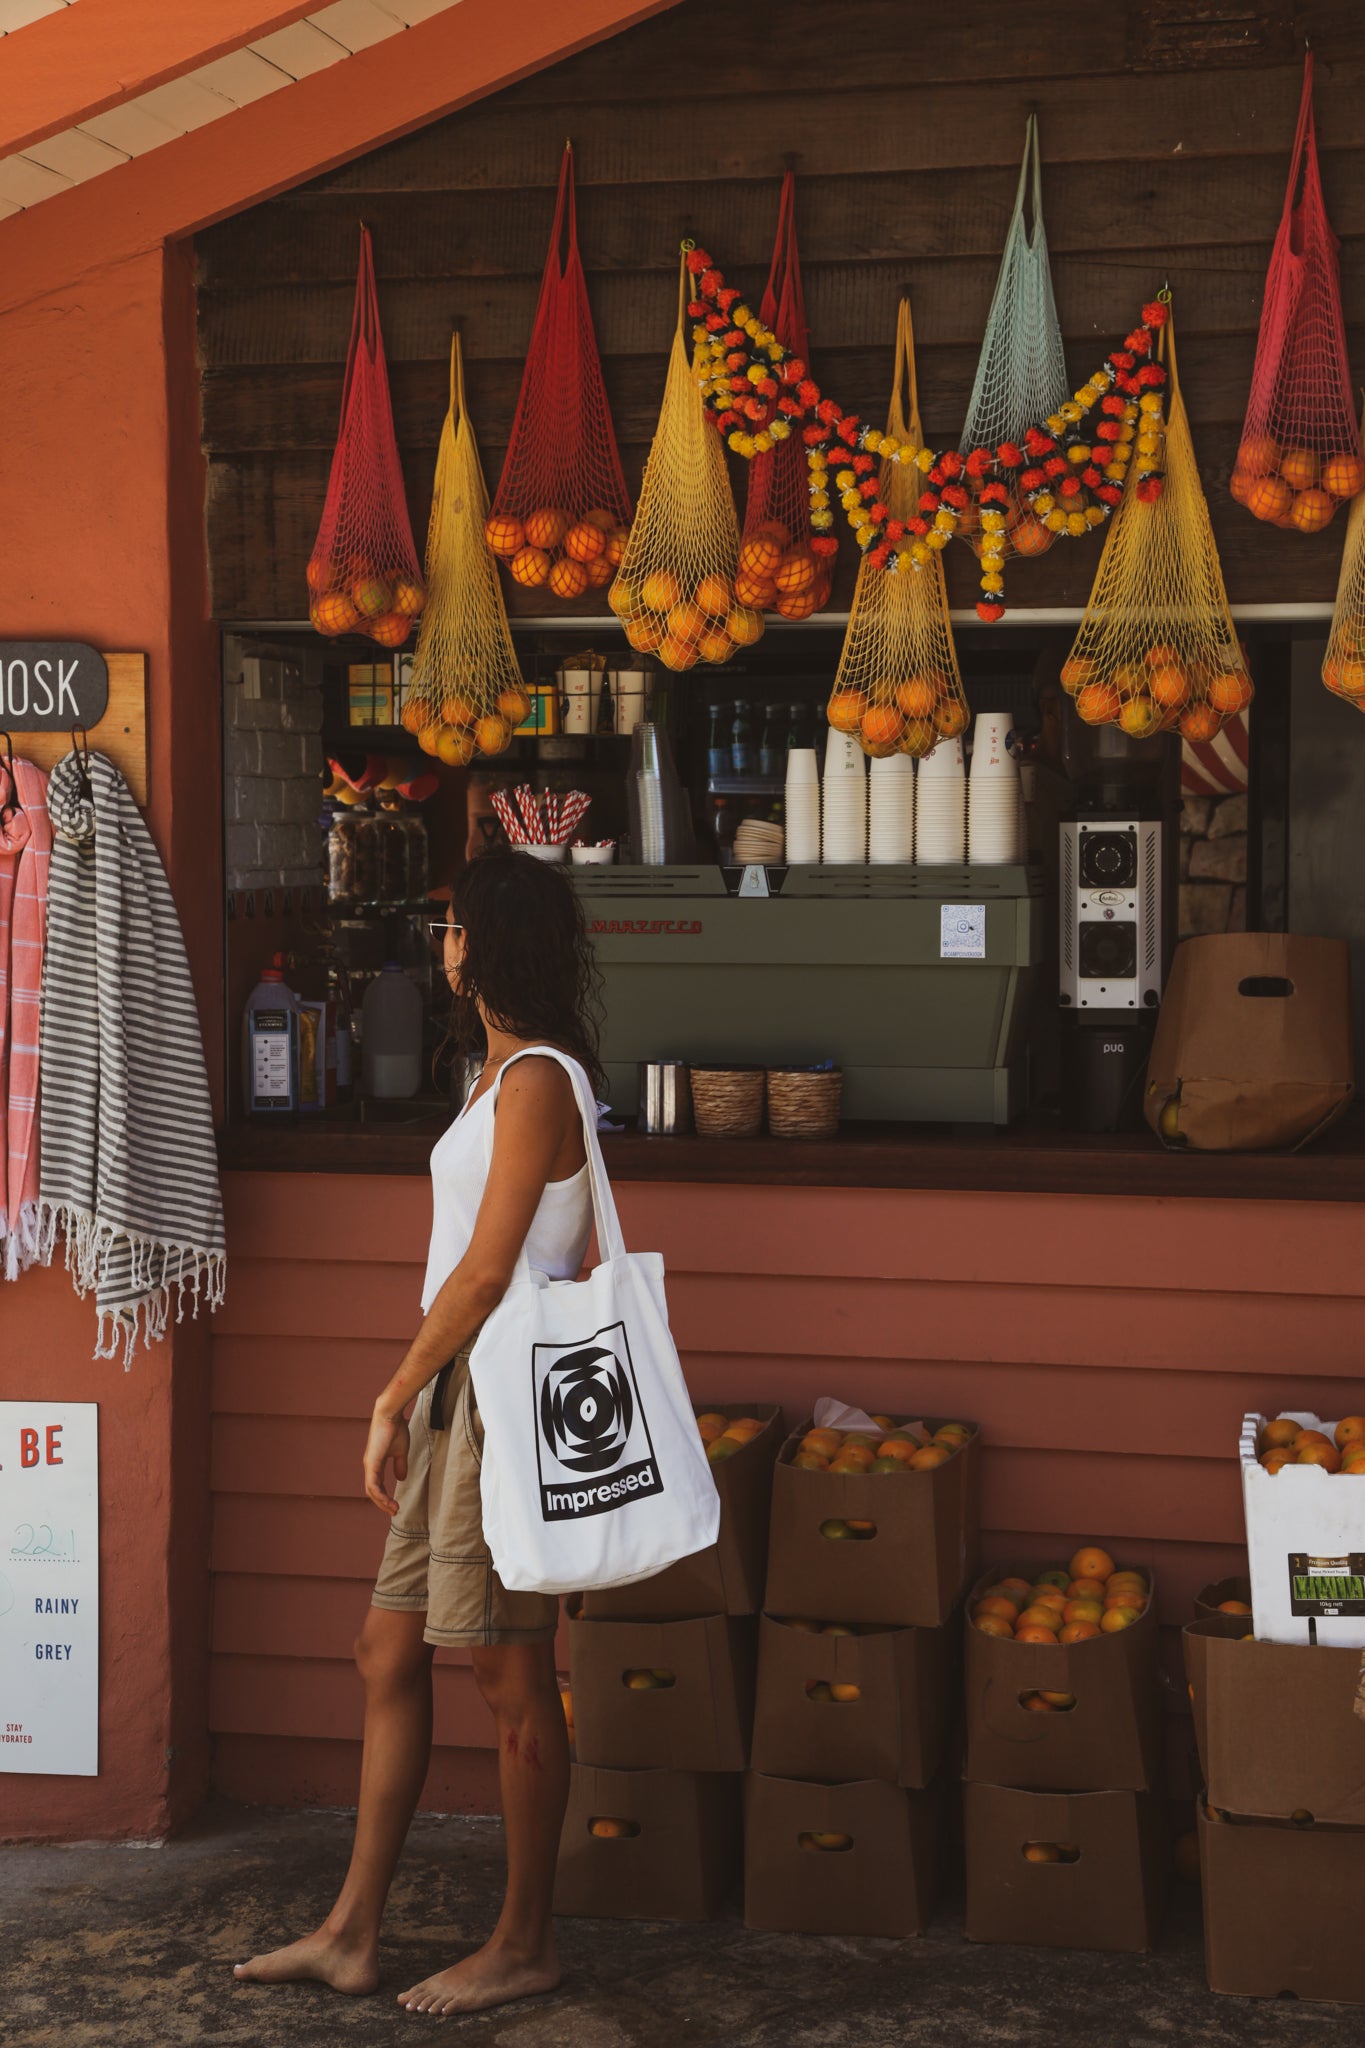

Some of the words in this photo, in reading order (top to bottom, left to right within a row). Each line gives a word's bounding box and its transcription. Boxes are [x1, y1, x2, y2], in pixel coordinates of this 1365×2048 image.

[20, 1425, 64, 1469] BE
[546, 1465, 655, 1512] Impressed
[35, 1598, 79, 1614] RAINY
[35, 1644, 72, 1661] GREY
[6, 1723, 23, 1732] STAY
[0, 1735, 33, 1744] YDRATED
